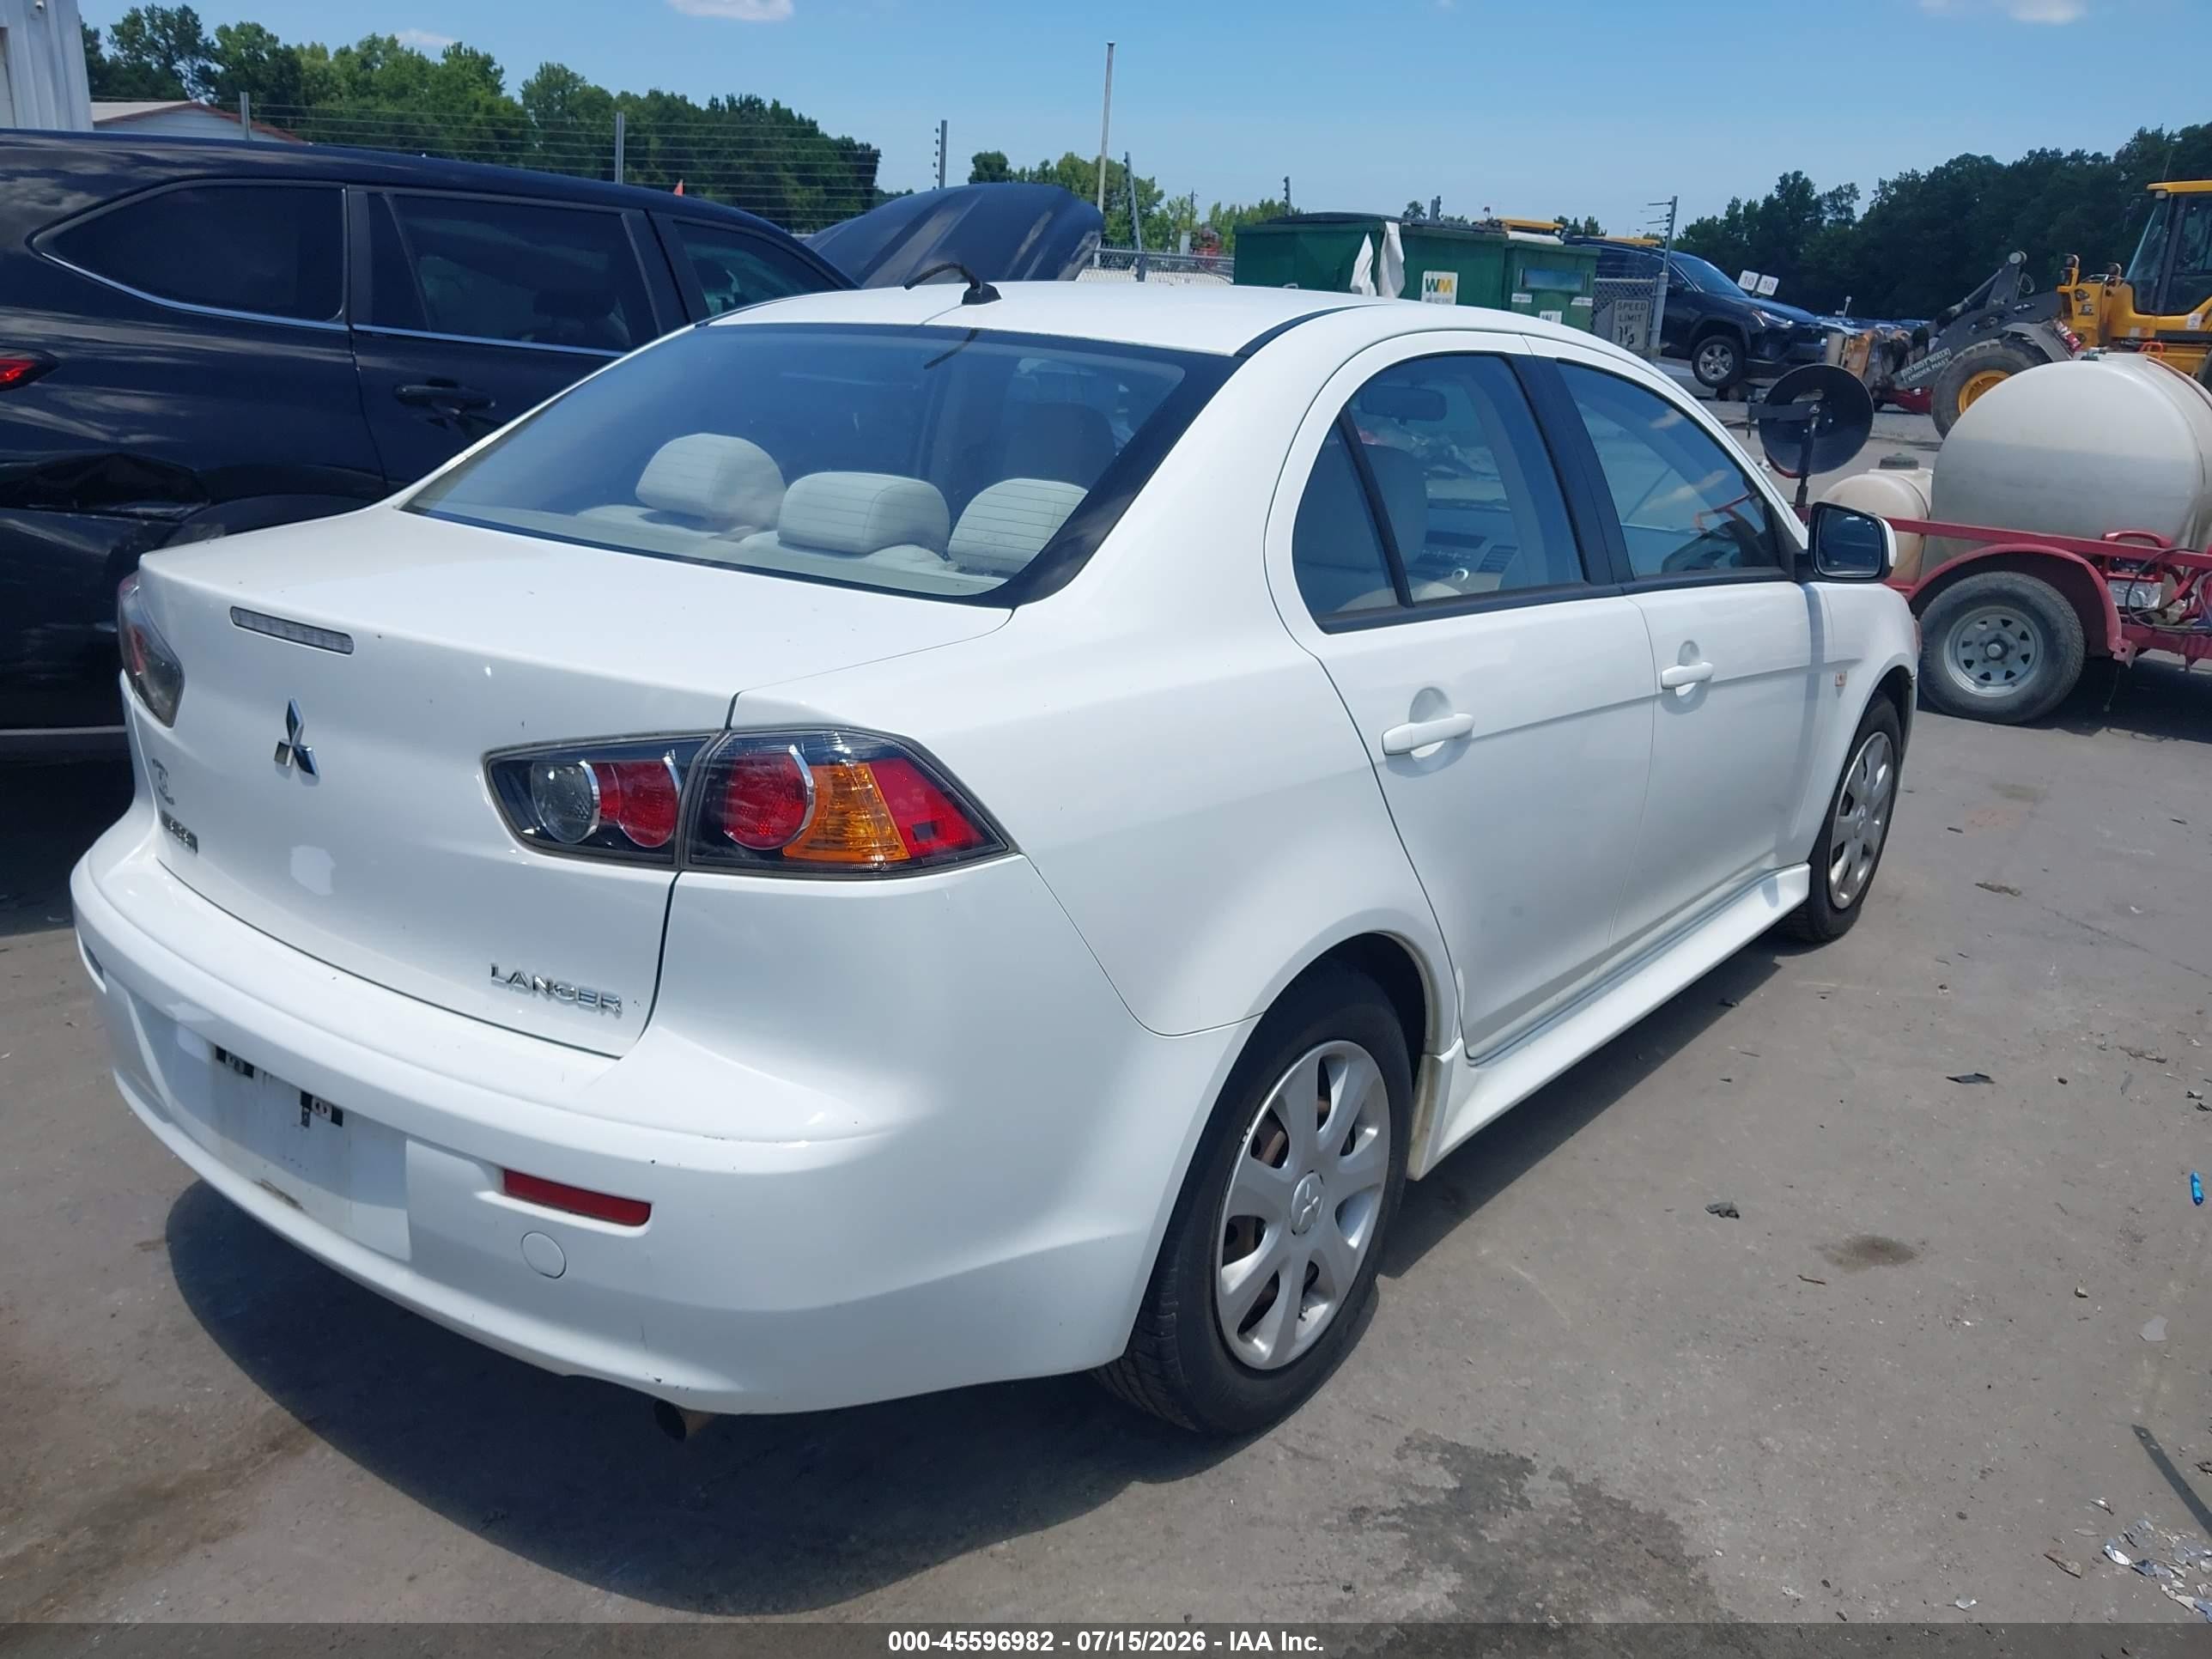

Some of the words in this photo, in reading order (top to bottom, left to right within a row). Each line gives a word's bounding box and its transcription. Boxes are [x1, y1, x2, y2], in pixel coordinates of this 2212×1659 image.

[1425, 278, 1453, 294] WM
[1617, 301, 1647, 310] SPEED
[1909, 367, 1931, 380] UNDER
[1931, 357, 1949, 369] MAST
[490, 963, 622, 1012] LANCER
